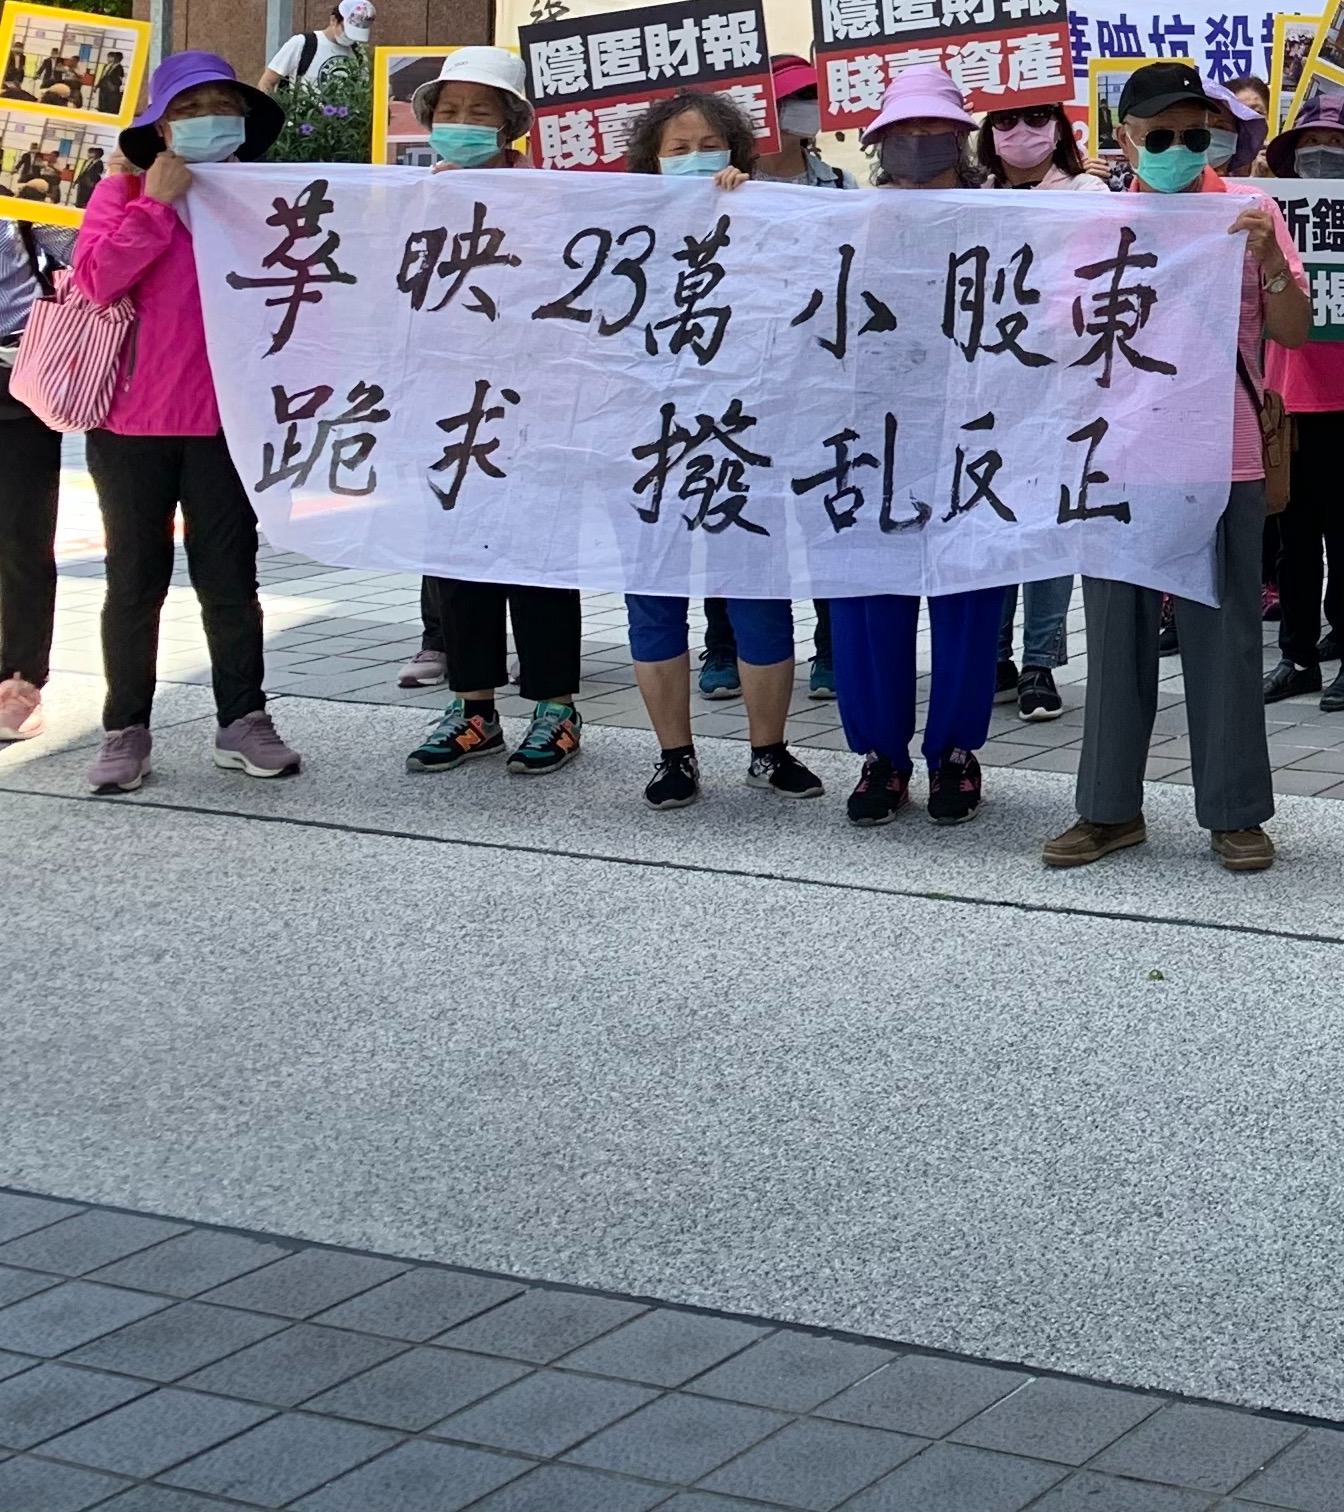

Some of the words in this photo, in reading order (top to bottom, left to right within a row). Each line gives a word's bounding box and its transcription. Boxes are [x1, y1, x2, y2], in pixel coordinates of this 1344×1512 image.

[529, 10, 763, 100] 隱匿財報
[826, 33, 1066, 116] 賤資產
[538, 85, 772, 170] 賤賣
